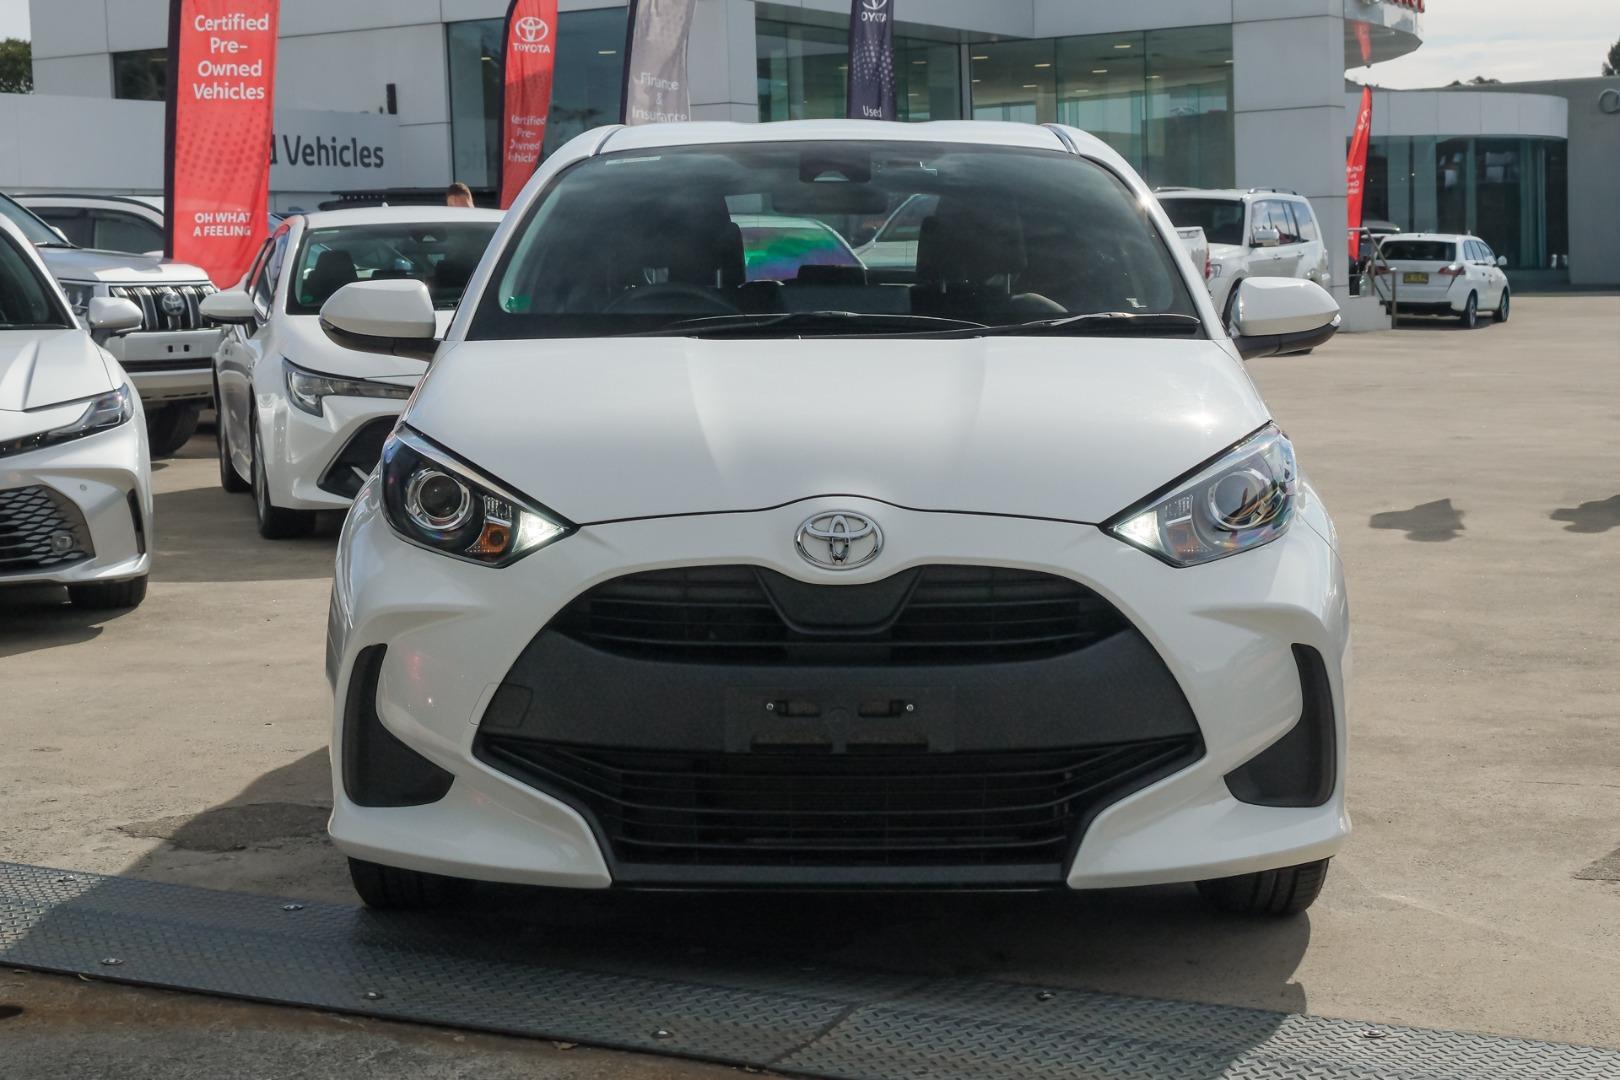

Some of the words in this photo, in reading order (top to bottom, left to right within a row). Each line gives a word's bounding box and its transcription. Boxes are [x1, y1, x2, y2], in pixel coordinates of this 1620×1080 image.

[194, 13, 269, 31] Certified
[210, 37, 248, 54] Pre-
[512, 42, 551, 54] TOYOTA
[197, 59, 262, 77] Owned
[192, 82, 265, 100] Vehicles
[862, 105, 882, 117] Used
[282, 134, 384, 169] Vehicles
[194, 212, 214, 224] OH
[215, 211, 251, 224] WHAT
[192, 226, 202, 237] A
[203, 225, 252, 238] FEELING
